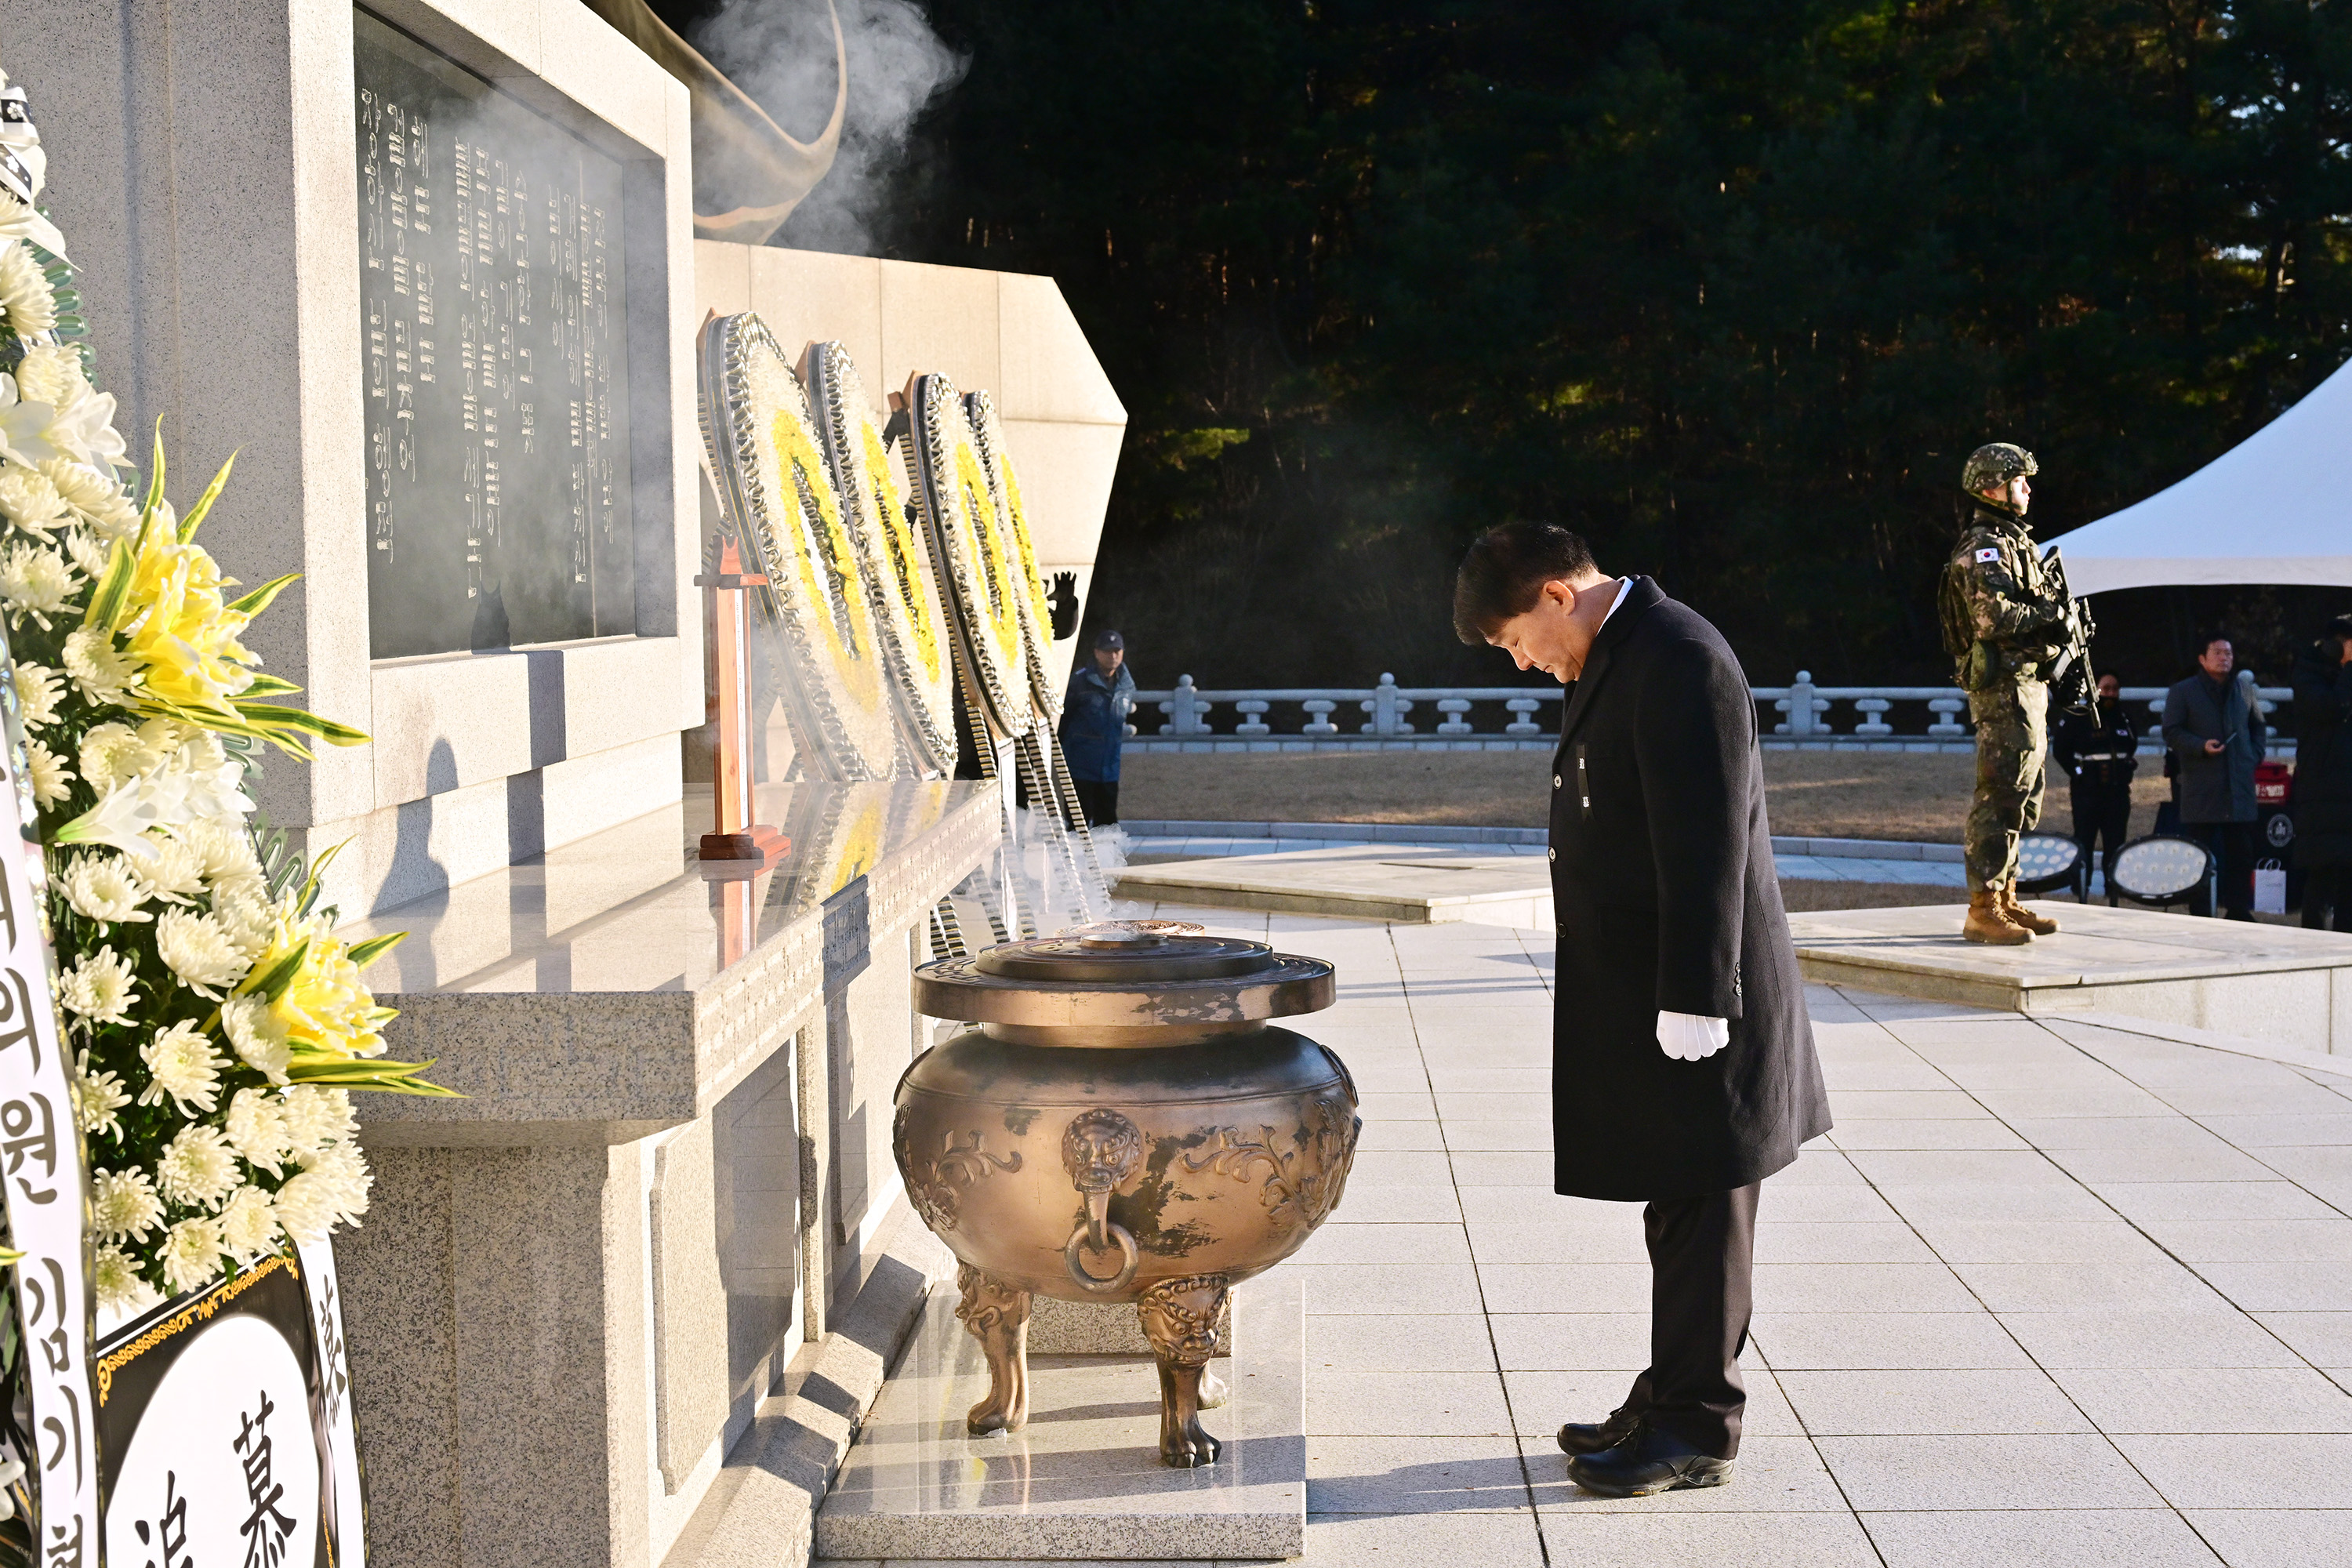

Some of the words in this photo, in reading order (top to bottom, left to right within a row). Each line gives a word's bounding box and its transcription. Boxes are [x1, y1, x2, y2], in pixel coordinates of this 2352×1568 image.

[361, 87, 385, 272] 장하신
[387, 103, 411, 297] 걸음을
[411, 115, 431, 235] 해도
[455, 136, 475, 301] 불멸의
[475, 147, 493, 266] 푸른
[495, 159, 511, 261] 길이
[514, 169, 531, 325] 숭고한
[548, 183, 564, 360] 님이시여
[564, 194, 578, 282] 겨레
[580, 200, 593, 309] 등불
[593, 206, 608, 339] 조국이
[369, 297, 390, 409] 님의
[416, 261, 436, 383] 달도
[461, 314, 478, 432] 얼을
[480, 280, 496, 388] 하늘
[499, 280, 516, 412] 기리어
[519, 347, 533, 385] 그
[567, 294, 580, 387] 위해
[394, 319, 416, 483] 멈추어
[521, 402, 535, 454] 뜻
[570, 400, 583, 447] 몸
[598, 354, 611, 440] 바람
[372, 423, 394, 564] 행적
[463, 446, 482, 604] 새기노니
[484, 406, 501, 548] 드높이
[572, 461, 586, 583] 바치신
[601, 458, 614, 544] 앞에
